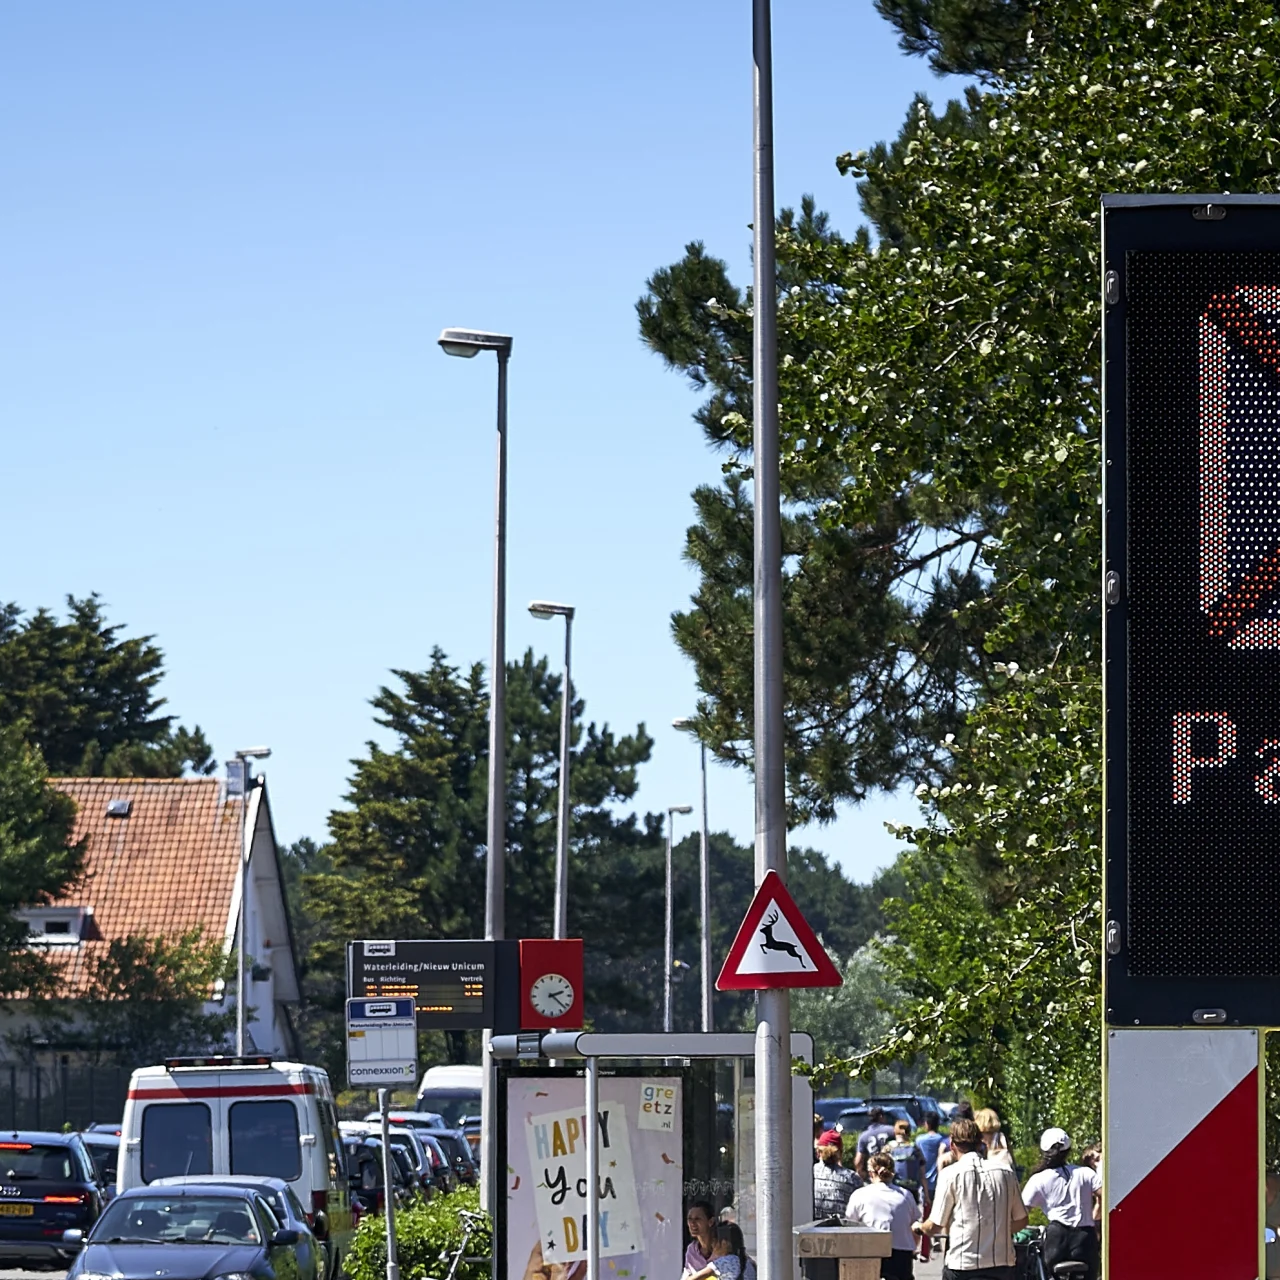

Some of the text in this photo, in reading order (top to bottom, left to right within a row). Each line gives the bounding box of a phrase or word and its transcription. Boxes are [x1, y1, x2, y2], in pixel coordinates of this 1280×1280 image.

[451, 962, 485, 971] Unicum
[380, 976, 407, 984] Richting
[351, 1066, 404, 1076] connexxion
[644, 1086, 674, 1100] gre
[643, 1101, 673, 1115] etz
